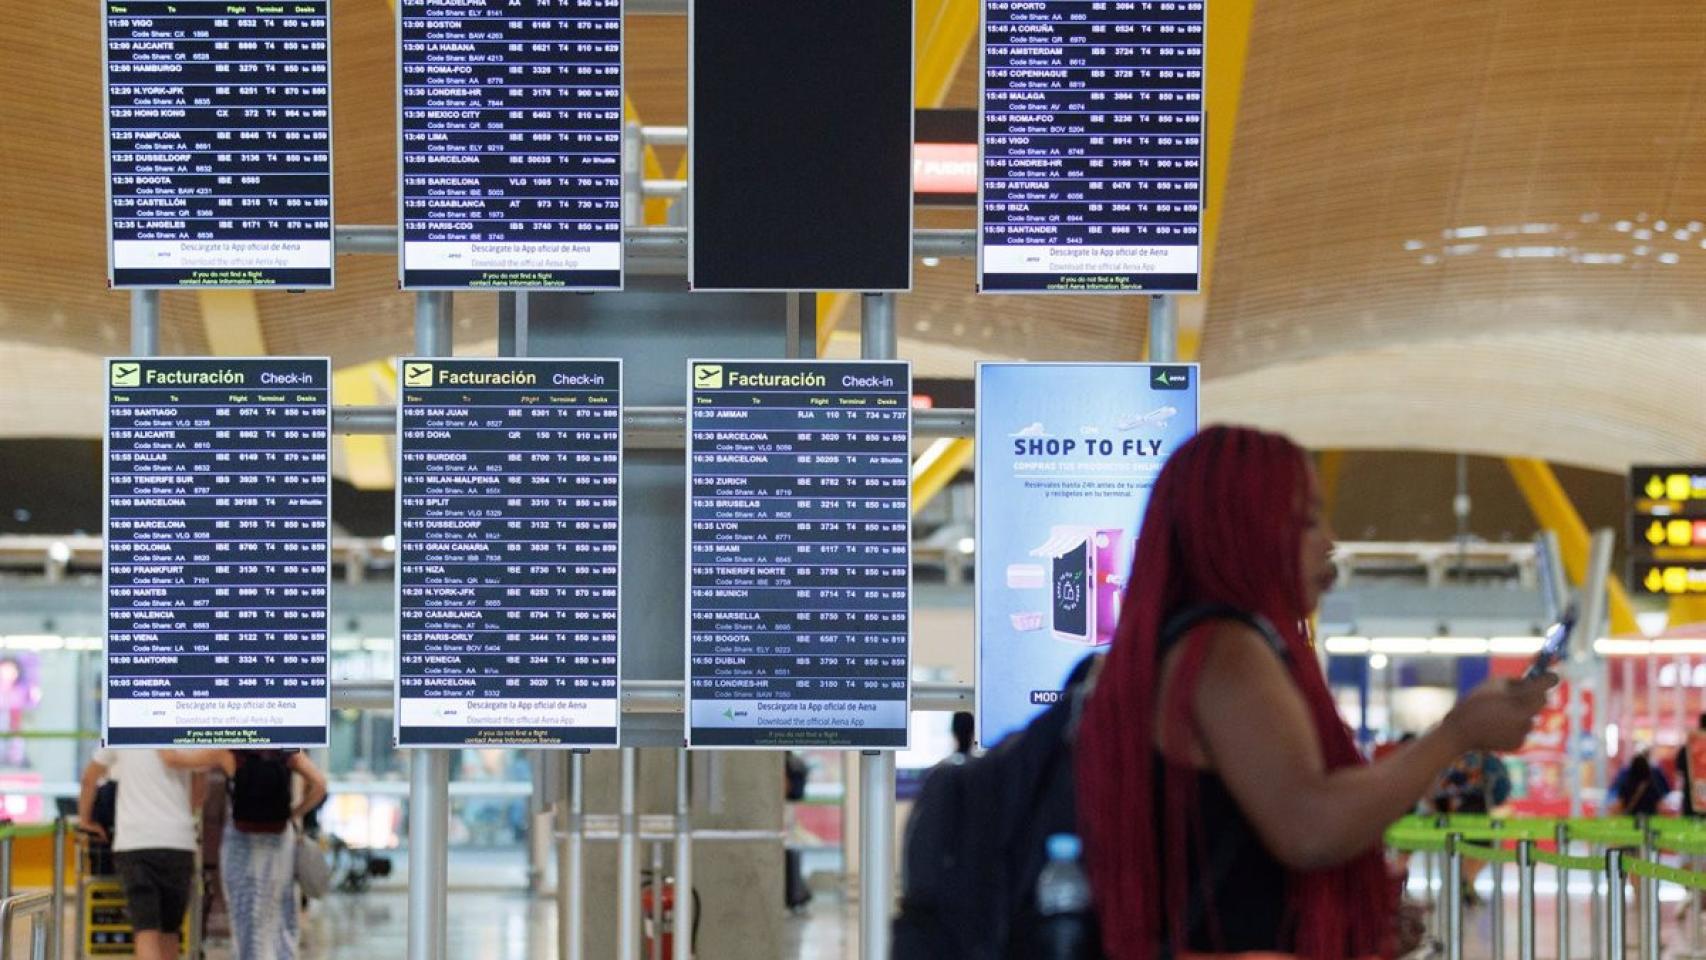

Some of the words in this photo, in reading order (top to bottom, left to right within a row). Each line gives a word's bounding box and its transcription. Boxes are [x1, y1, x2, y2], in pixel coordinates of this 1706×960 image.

[1019, 24, 1053, 32] CORUÑA
[136, 198, 186, 206] CASTELLÓN
[147, 371, 243, 383] Facturación
[261, 373, 312, 384] Check-in
[439, 371, 536, 384] Facturación
[553, 374, 604, 384] Check-in
[729, 373, 825, 386] Facturación
[842, 376, 893, 386] Check-in
[1015, 439, 1075, 455] SHOP
[1086, 439, 1112, 455] TO
[1123, 440, 1162, 455] FLY
[1034, 693, 1057, 702] MOD
[468, 701, 507, 710] Descárgate
[758, 703, 797, 712] Descárgate
[809, 703, 822, 711] App
[851, 717, 864, 726] App
